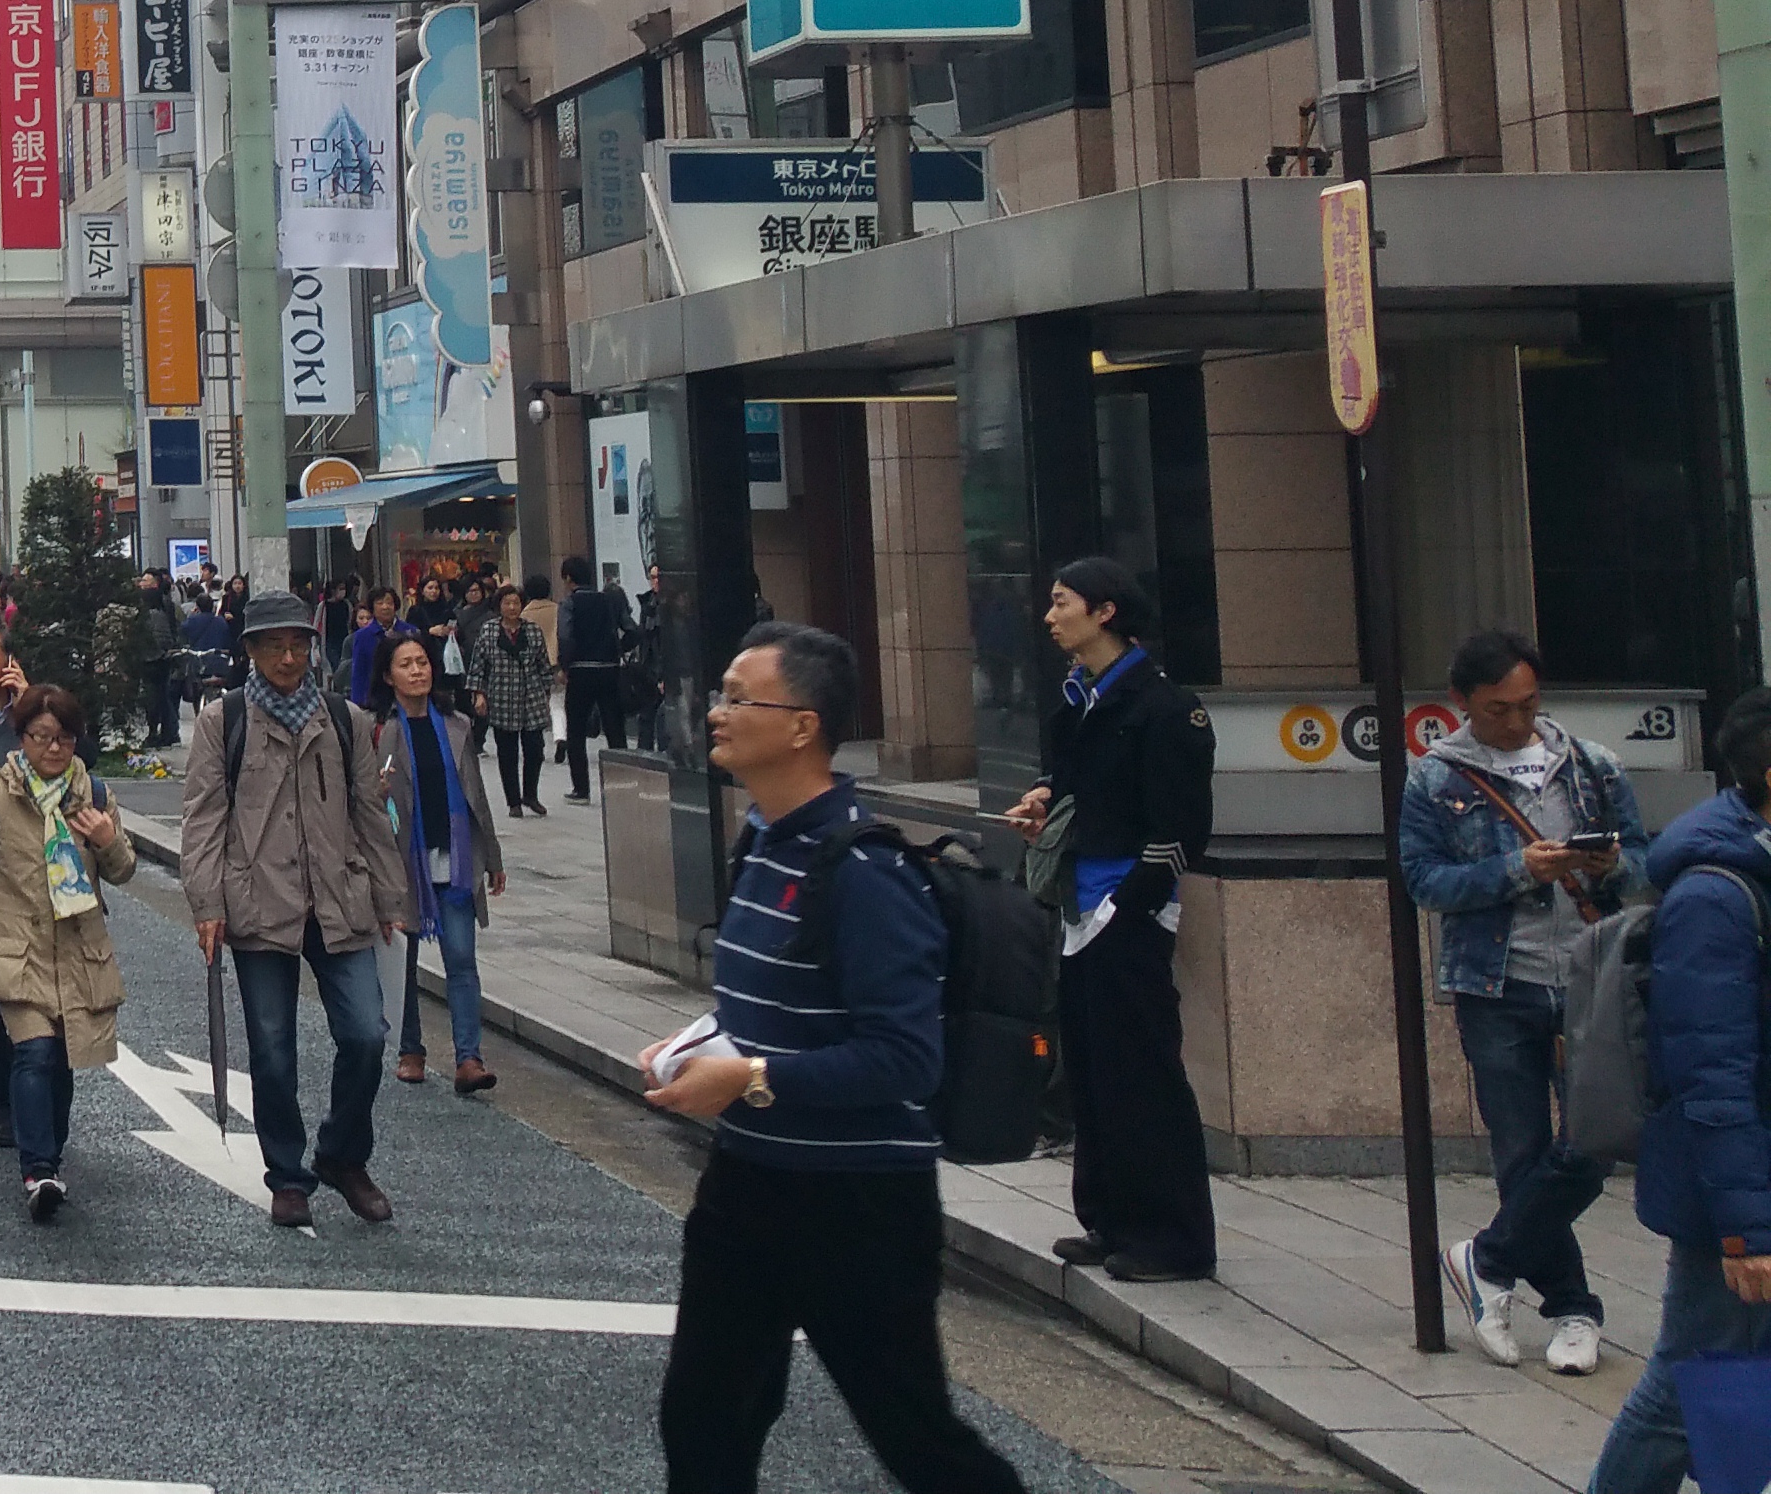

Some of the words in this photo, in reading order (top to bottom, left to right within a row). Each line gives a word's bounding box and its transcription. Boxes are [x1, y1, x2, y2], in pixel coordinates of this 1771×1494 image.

[92, 7, 112, 94] 輸入洋食器
[303, 62, 329, 73] 3.31
[80, 71, 92, 96] 4F
[290, 137, 385, 155] TOKYU
[290, 157, 385, 175] PLAZA
[771, 159, 877, 180] 東京メトロ
[290, 177, 385, 195] GINZA
[432, 161, 442, 213] GINZA
[780, 181, 825, 198] Tokyo
[828, 181, 876, 197] Metro
[1303, 719, 1315, 731] G
[1363, 719, 1377, 731] H
[1424, 719, 1440, 731] M
[1298, 732, 1321, 746] 09
